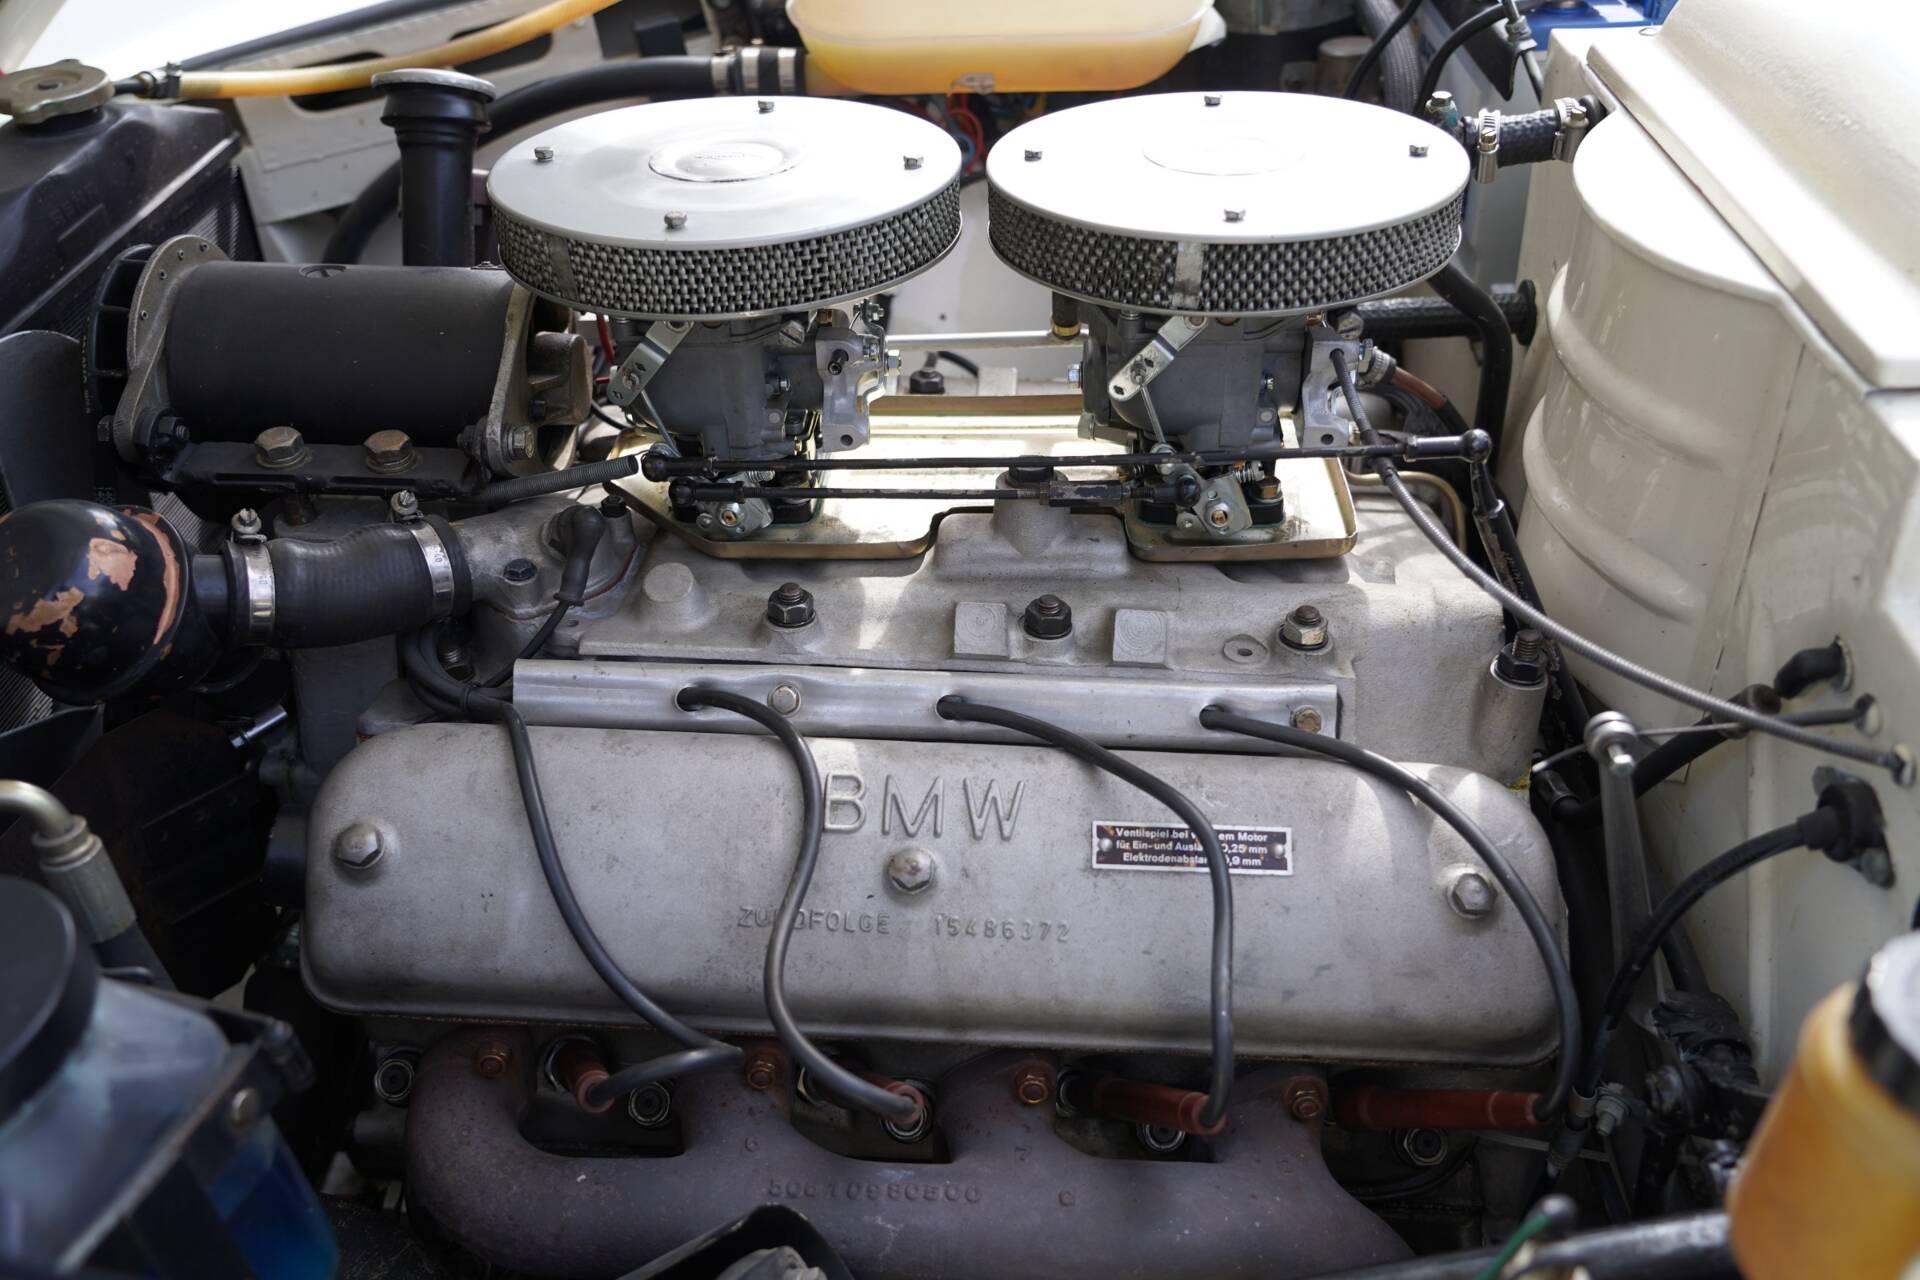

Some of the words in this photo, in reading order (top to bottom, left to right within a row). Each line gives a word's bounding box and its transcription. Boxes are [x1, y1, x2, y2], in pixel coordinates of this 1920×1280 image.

[823, 771, 1026, 841] BMW
[1116, 828, 1169, 839] Ventilspiel
[1172, 830, 1189, 838] bei
[1237, 829, 1268, 841] Motor
[1116, 841, 1130, 849] für
[1248, 846, 1268, 854] mm
[1242, 858, 1262, 866] mm
[736, 905, 891, 935] ZUDFOLGE
